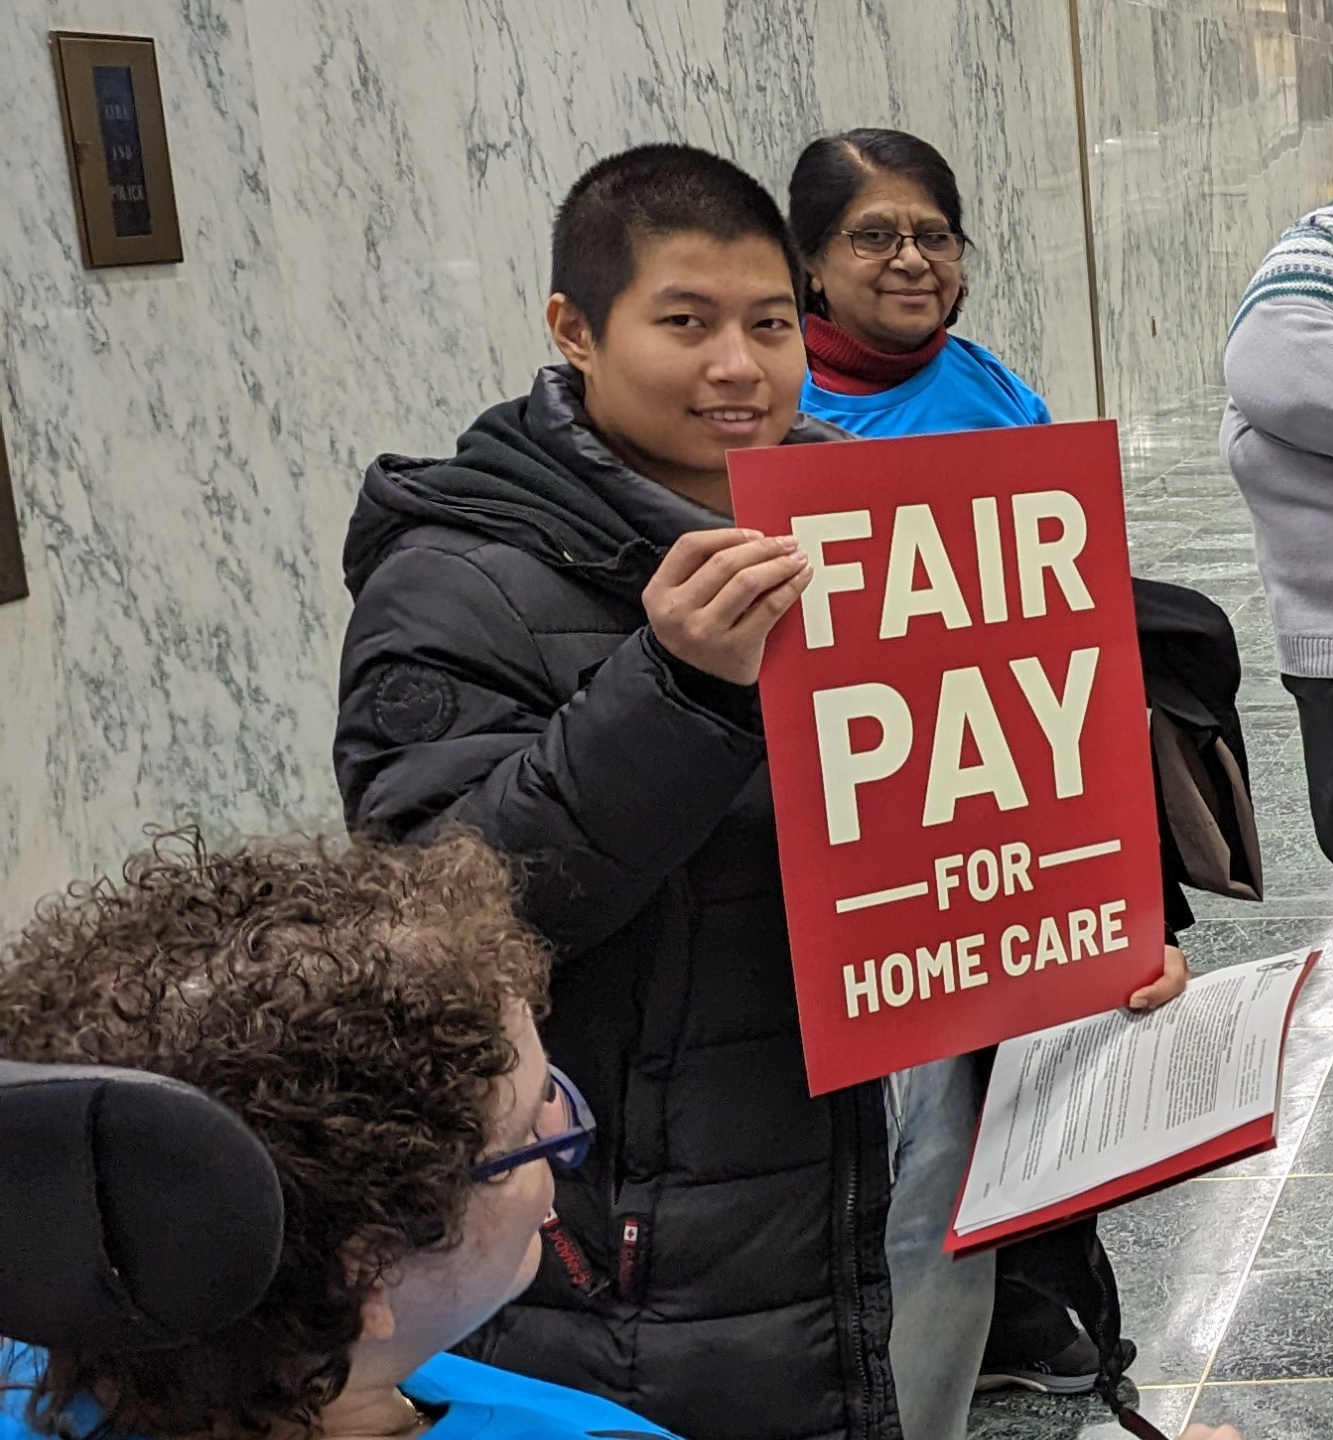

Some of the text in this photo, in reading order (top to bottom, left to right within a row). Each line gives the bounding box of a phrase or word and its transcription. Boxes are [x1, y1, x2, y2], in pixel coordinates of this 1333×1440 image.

[791, 489, 1095, 649] FAIR
[812, 646, 1099, 846] PAY
[934, 842, 1034, 910] FOR
[842, 899, 1128, 1019] HOME CARE
